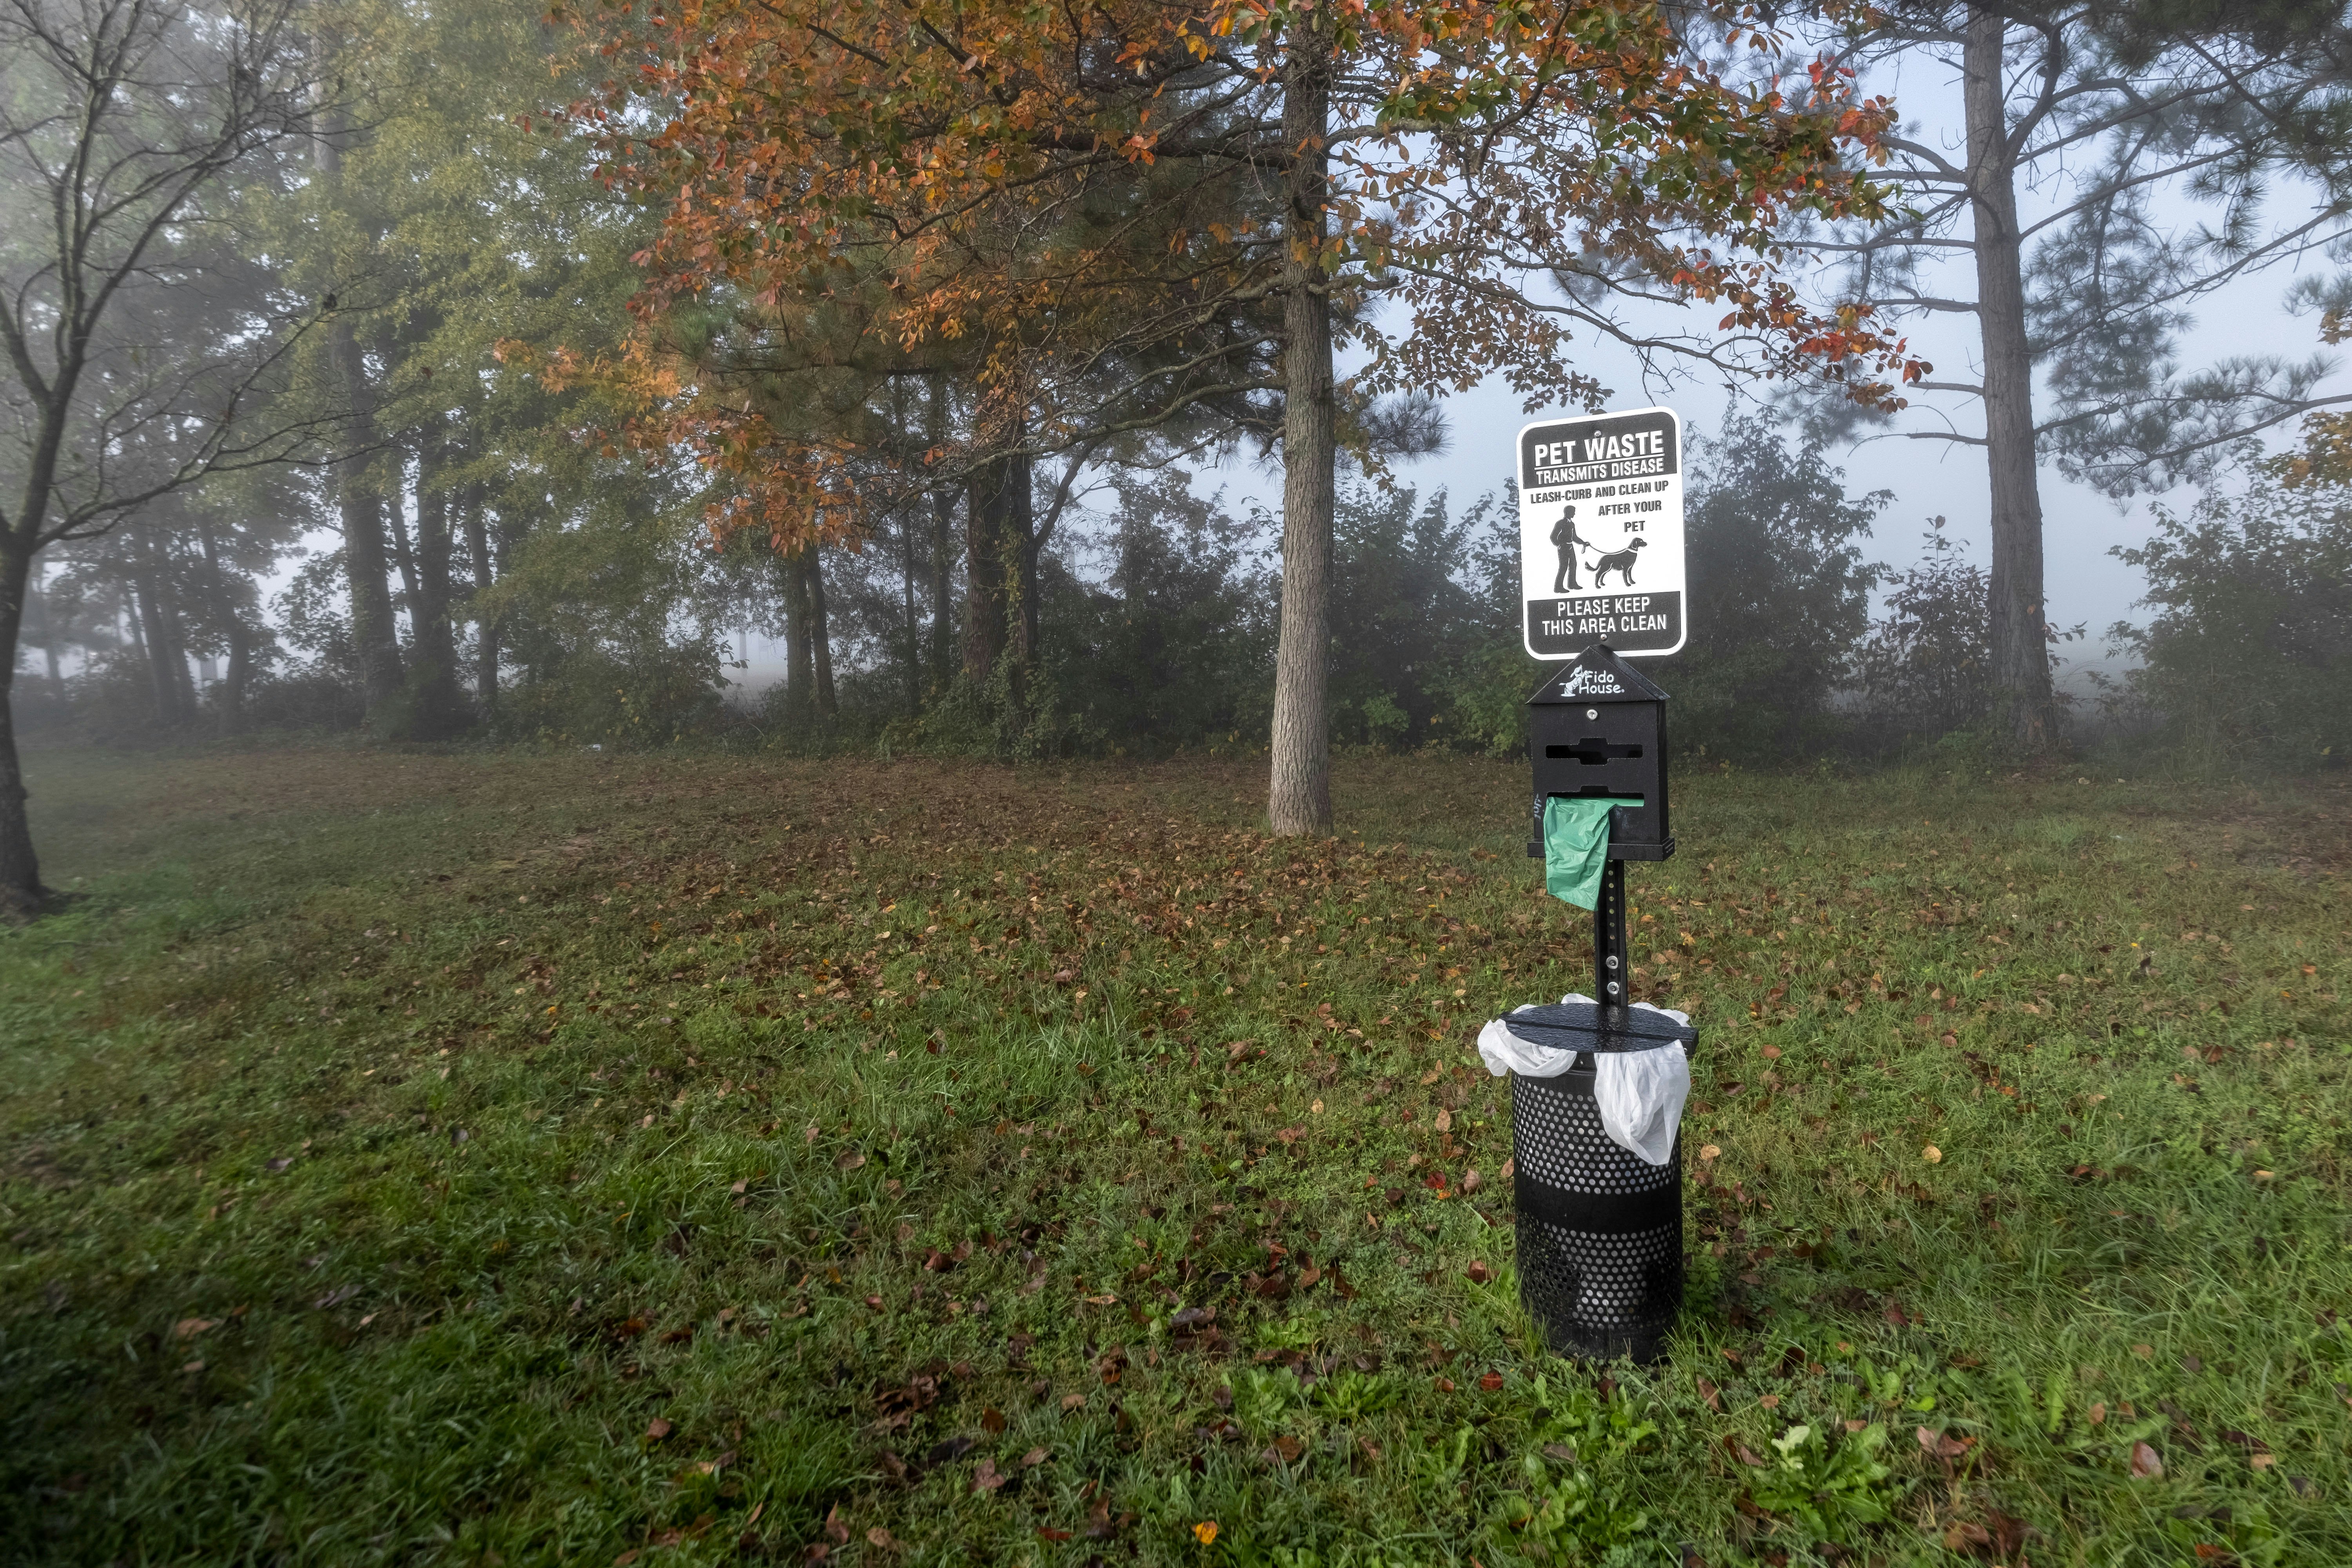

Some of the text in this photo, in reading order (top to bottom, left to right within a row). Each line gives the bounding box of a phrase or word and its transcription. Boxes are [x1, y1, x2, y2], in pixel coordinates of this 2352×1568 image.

[1535, 430, 1664, 466] PET WASTE
[1536, 458, 1664, 485] TRANSMITS DISEASE
[1530, 480, 1669, 504] LEASH-CURB AND CLEAN UP
[1598, 500, 1662, 516] AFTER YOUR
[1624, 521, 1645, 532] PET
[1557, 596, 1651, 617] PLEASE KEEP
[1542, 614, 1667, 635] THIS AREA CLEAN
[1585, 670, 1614, 684] Fido
